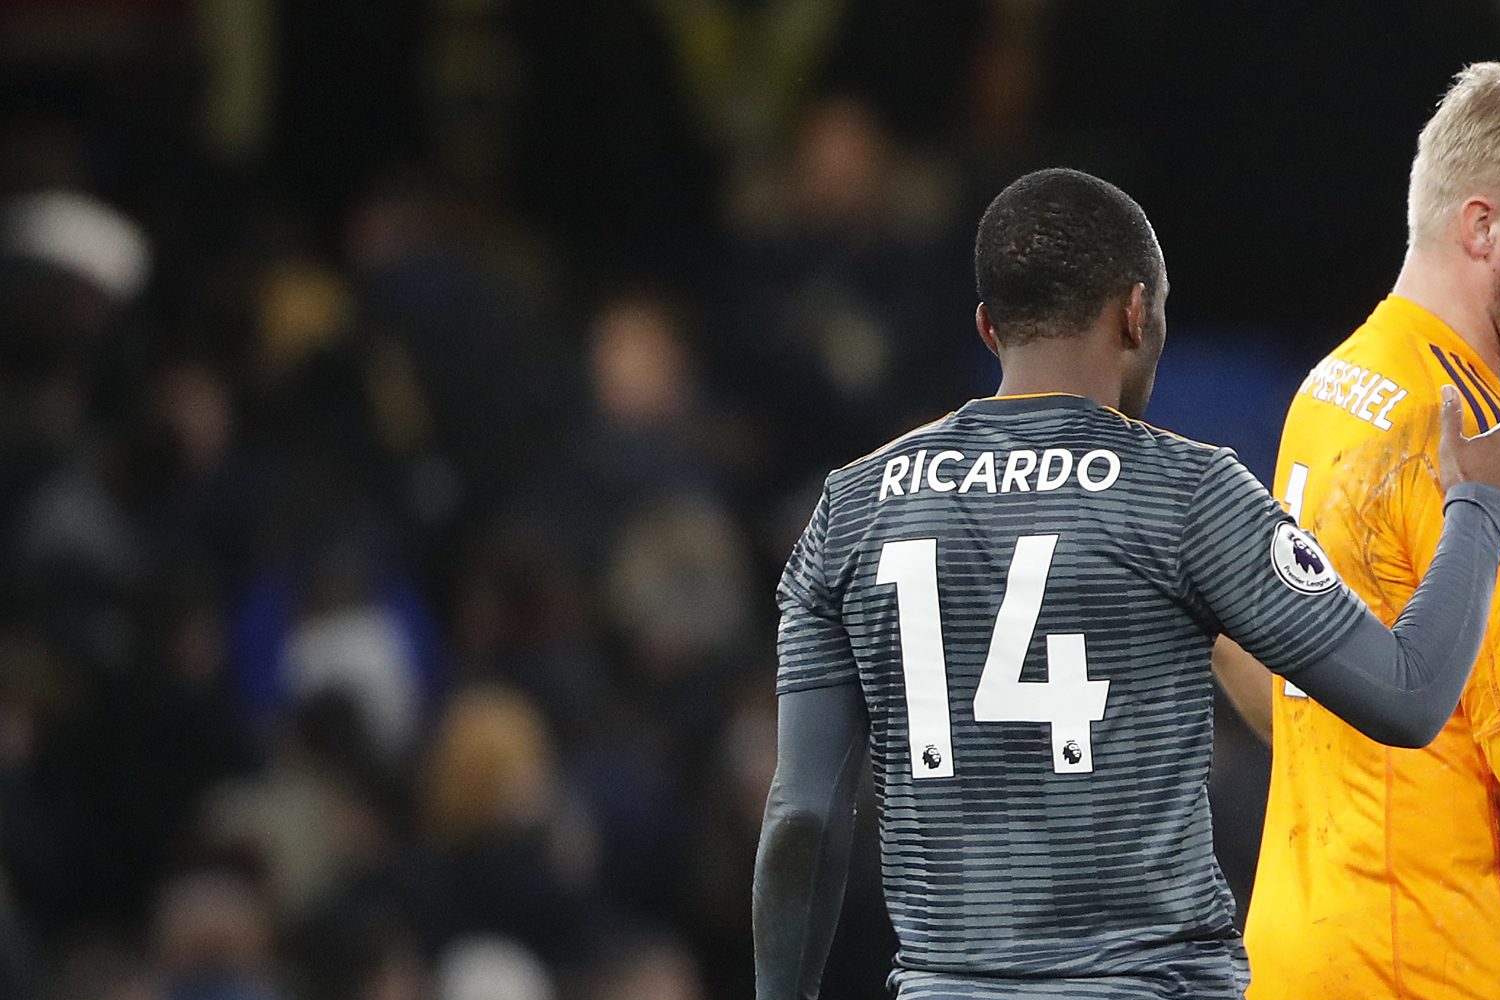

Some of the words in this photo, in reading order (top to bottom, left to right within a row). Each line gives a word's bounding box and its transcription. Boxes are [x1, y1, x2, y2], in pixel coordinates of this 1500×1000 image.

[878, 448, 1122, 502] RICARDO
[1284, 564, 1305, 584] Premier
[1306, 577, 1331, 587] League
[876, 533, 1111, 779] 14
